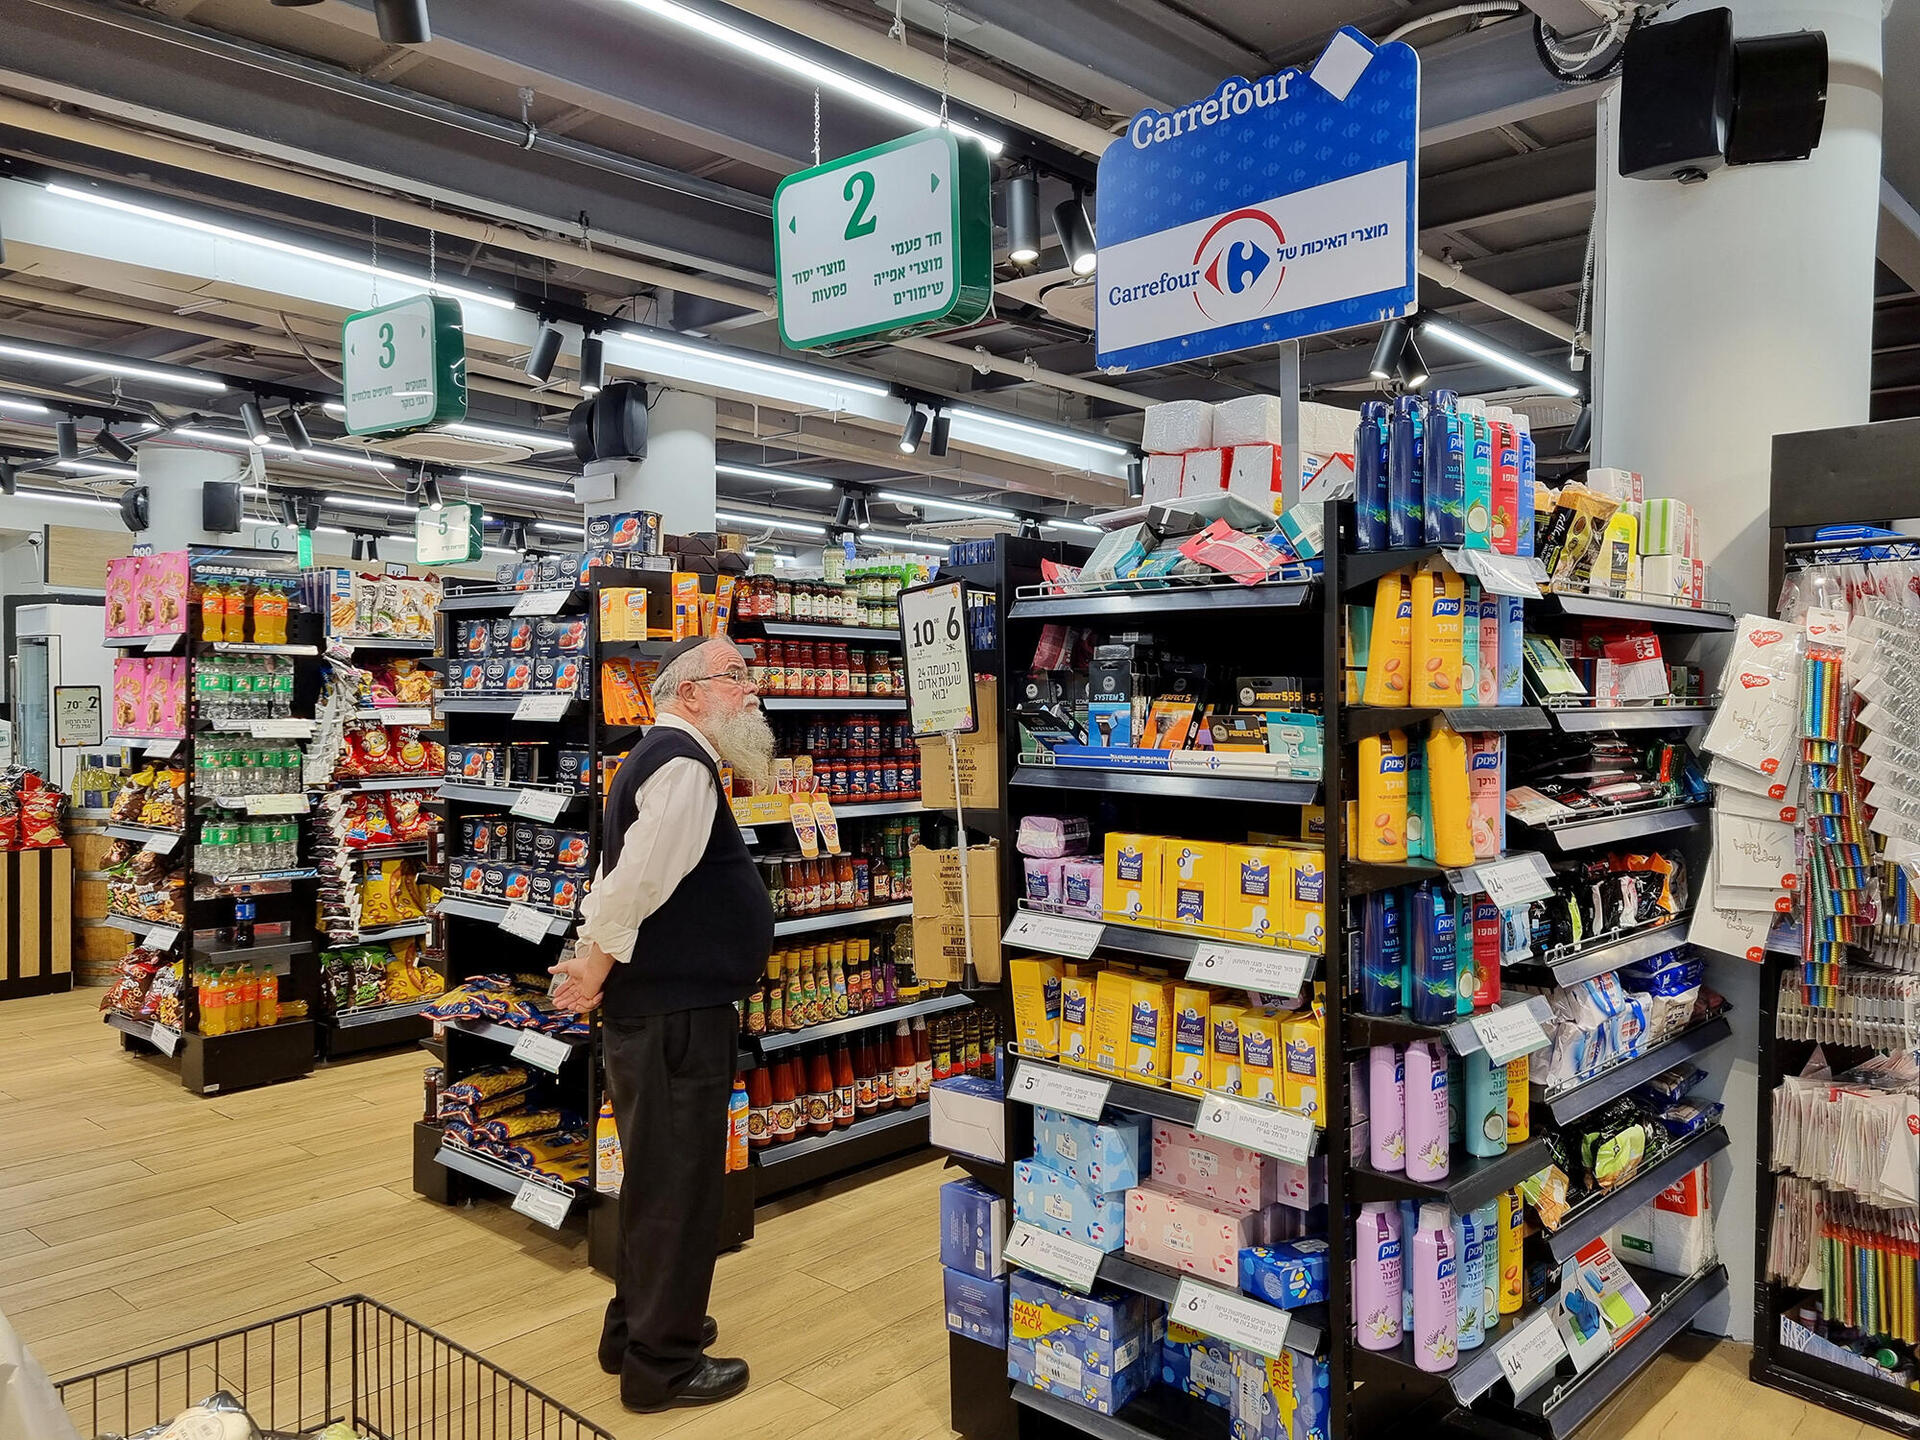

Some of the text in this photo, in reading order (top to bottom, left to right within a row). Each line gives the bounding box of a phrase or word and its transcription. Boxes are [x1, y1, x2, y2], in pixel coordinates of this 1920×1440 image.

[1132, 71, 1295, 150] Carrefour
[843, 171, 877, 241] 2
[891, 231, 942, 256] חד פעמי
[1277, 221, 1389, 262] מוצרי האיכות של
[792, 259, 846, 285] מוצרי יסוד
[874, 257, 943, 287] מוצרי אפייה
[812, 283, 847, 303] פסטות
[893, 281, 944, 305] שימורים
[1109, 269, 1200, 306] Carrefour
[379, 323, 395, 368] 3
[439, 513, 447, 535] 5
[270, 530, 280, 549] 6
[196, 565, 267, 577] GREAT TASTE
[194, 574, 250, 585] ZERO
[1436, 602, 1459, 614] פינוק
[947, 607, 960, 640] 6
[913, 620, 934, 647] 10
[918, 662, 960, 677] נר נשמה 24
[939, 674, 961, 687] שעות
[932, 689, 948, 700] יבוא
[1094, 693, 1125, 702] SYSTEM 3
[1185, 694, 1192, 702] 5
[1256, 692, 1288, 701] PERFECT 5
[88, 696, 97, 708] 2
[1254, 729, 1261, 739] 5
[1384, 759, 1404, 771] פינוק
[1476, 756, 1497, 768] פינוק
[1477, 777, 1497, 787] מרכך
[1118, 857, 1142, 869] Normal
[1242, 870, 1268, 882] Normal
[1296, 876, 1322, 888] Normal
[1478, 906, 1498, 920] פינוק
[1019, 923, 1028, 934] 4
[1477, 928, 1498, 936] שמפו
[1205, 955, 1215, 968] 6
[1064, 1000, 1084, 1012] Normal
[1135, 1012, 1154, 1025] Large
[1181, 1020, 1201, 1031] Large
[1482, 1027, 1498, 1044] 24
[1244, 1043, 1271, 1054] Normal
[1288, 1050, 1314, 1063] Normal
[1025, 1077, 1035, 1090] 5
[1212, 1109, 1222, 1123] 6
[1020, 1233, 1030, 1247] 7
[1188, 1297, 1198, 1311] 6
[1014, 1303, 1041, 1320] MAXI
[1014, 1315, 1043, 1331] PACK
[1281, 1351, 1290, 1392] MAXI
[1507, 1355, 1522, 1375] 14
[1272, 1358, 1281, 1391] ACK
